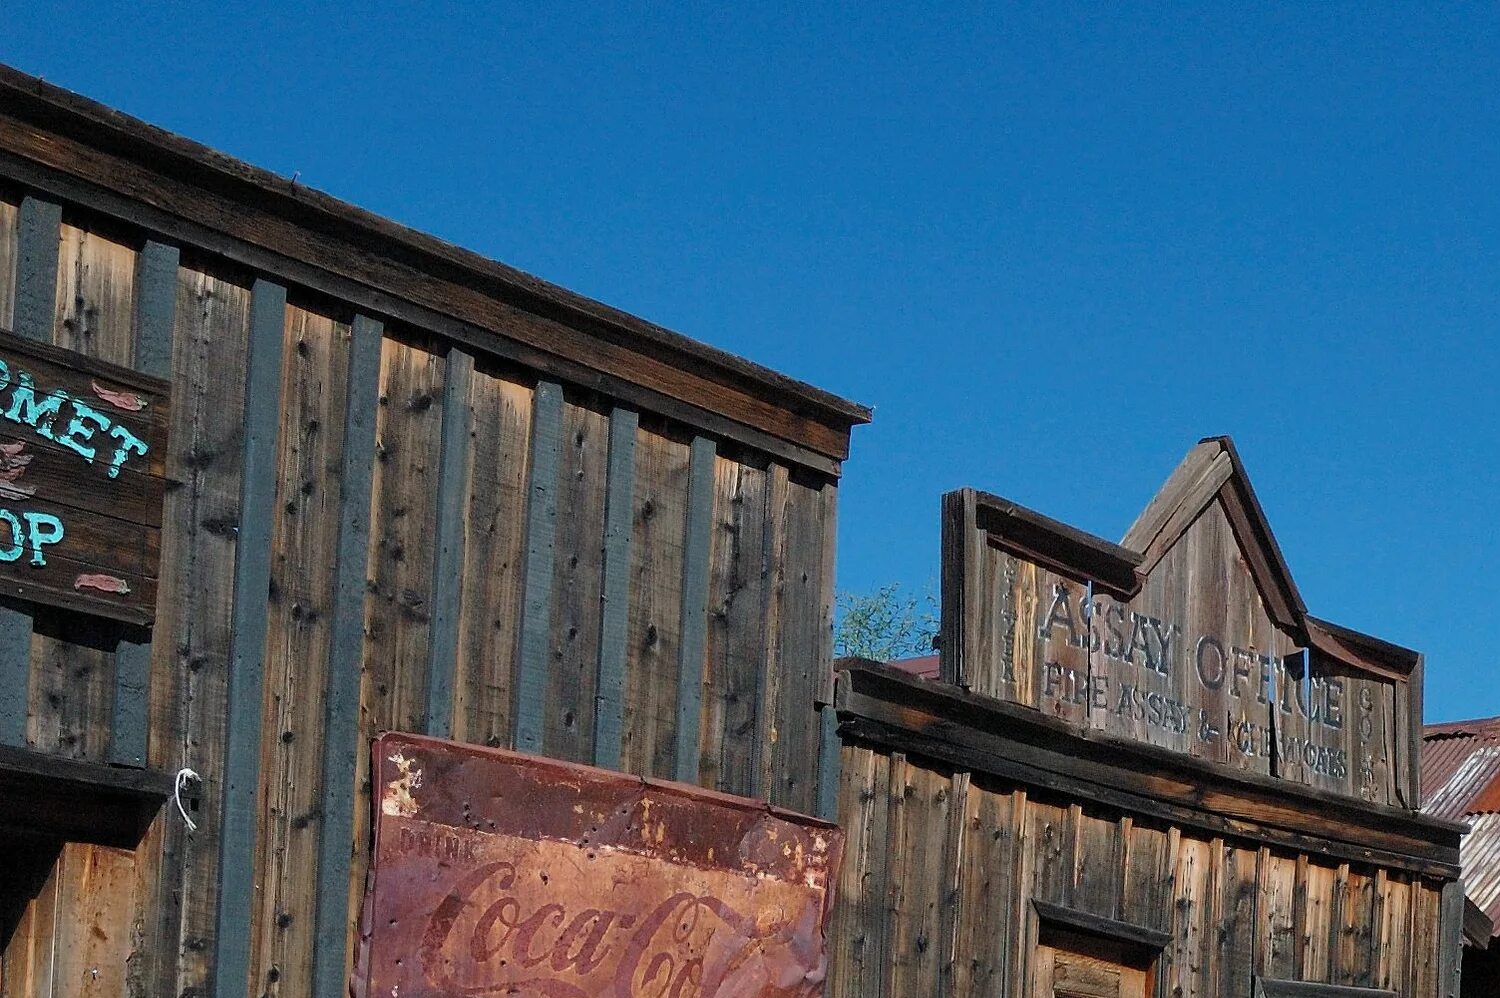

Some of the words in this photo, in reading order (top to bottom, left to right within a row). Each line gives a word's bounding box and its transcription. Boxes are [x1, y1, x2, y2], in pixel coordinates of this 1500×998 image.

[1038, 582, 1182, 677] ASSAY
[1196, 635, 1343, 730] OFFICE
[1043, 663, 1108, 708] FIRE
[1117, 682, 1190, 734] ASSAY
[1198, 708, 1219, 743] &
